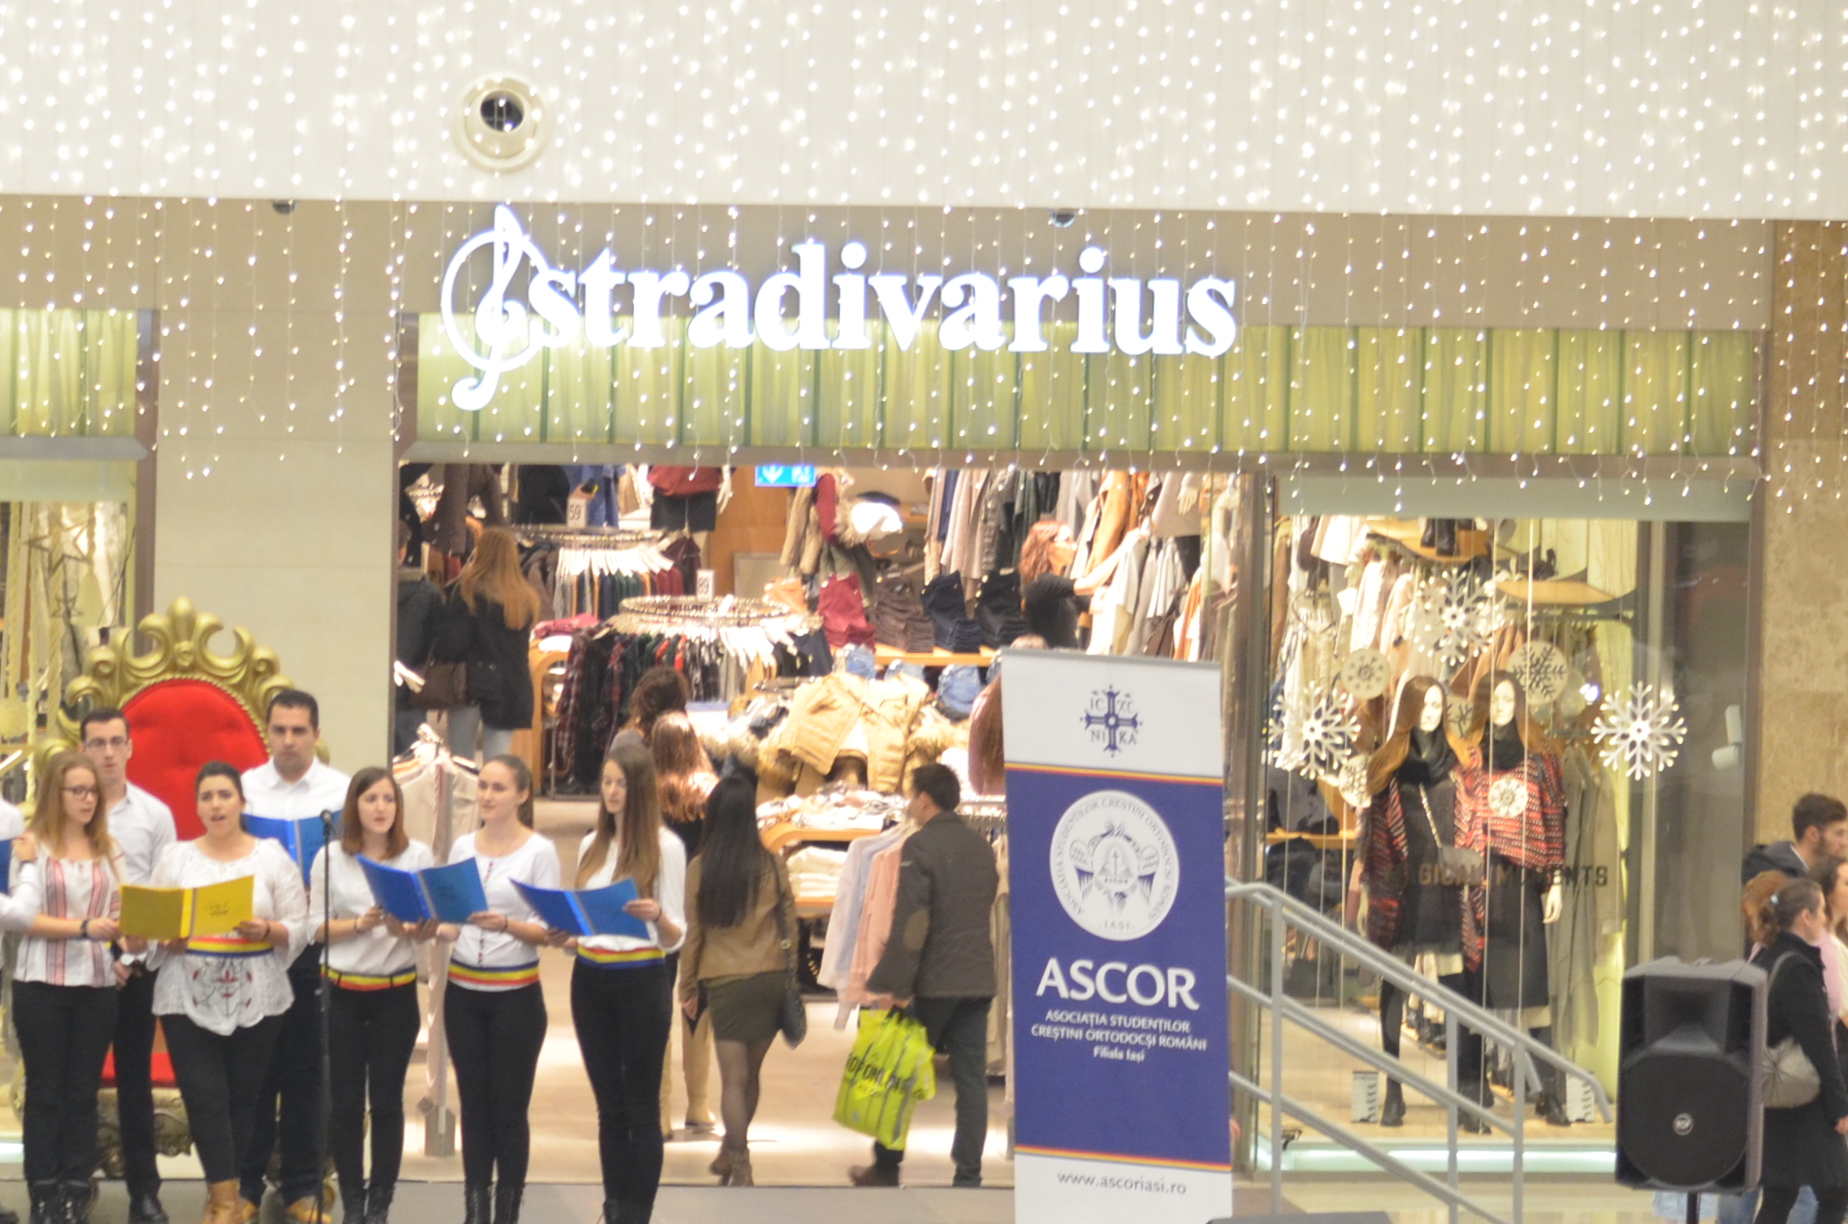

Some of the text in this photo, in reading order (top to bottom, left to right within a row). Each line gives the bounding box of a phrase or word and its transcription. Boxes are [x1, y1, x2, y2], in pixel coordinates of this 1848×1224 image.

[528, 242, 1237, 357] stradivarius
[1035, 956, 1201, 1011] ASCOR
[1093, 1046, 1124, 1060] Filiala
[1056, 1172, 1187, 1195] www.ascoriasi.ro
